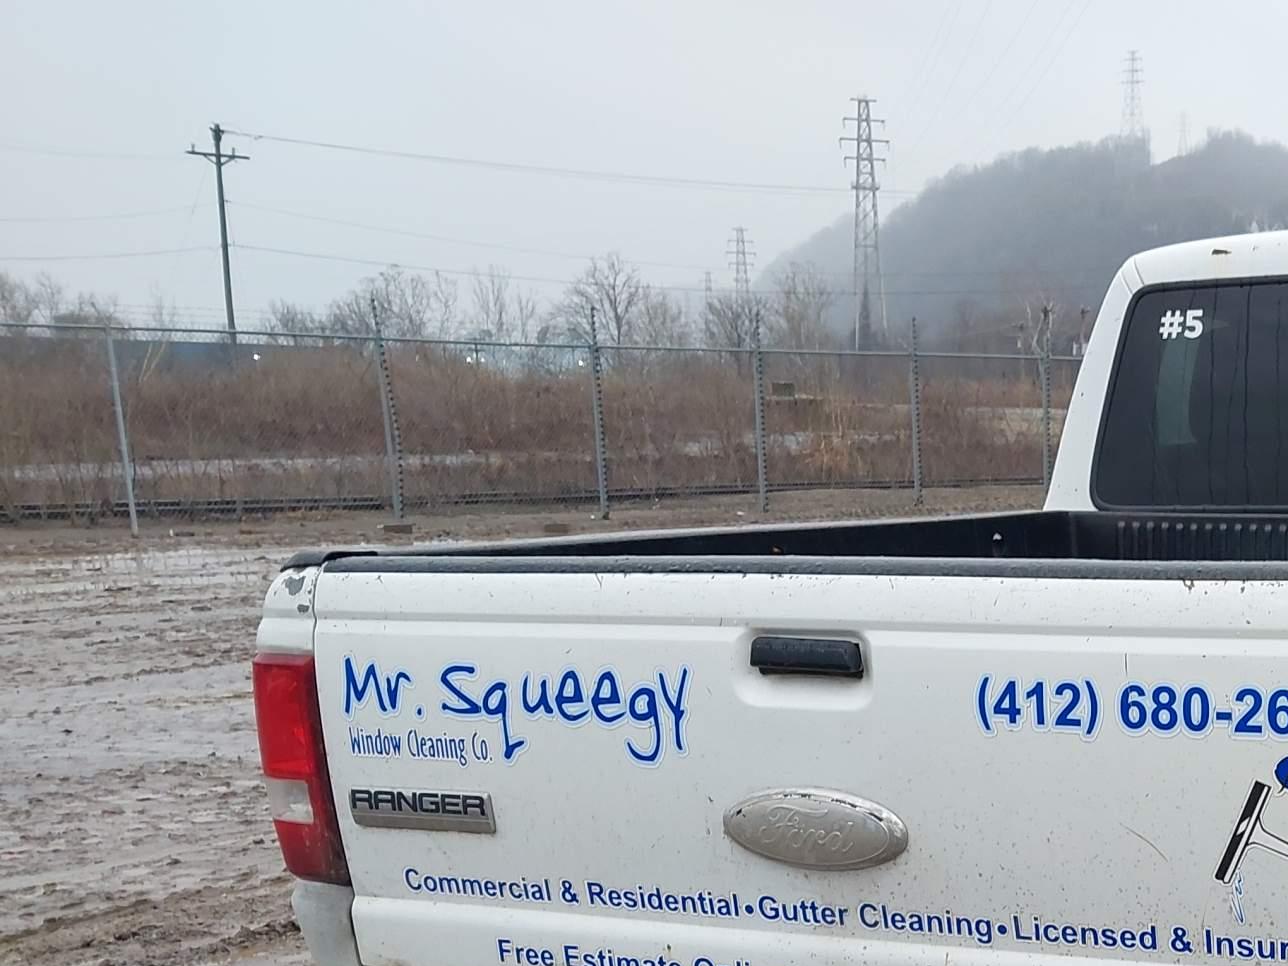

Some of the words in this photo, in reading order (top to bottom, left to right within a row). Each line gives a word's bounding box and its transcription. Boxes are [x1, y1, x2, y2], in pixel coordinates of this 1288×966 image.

[1159, 309, 1203, 339] #5
[344, 657, 423, 717] Mr.
[440, 665, 688, 761] Squeegy
[978, 676, 1098, 735] (412)
[348, 727, 402, 757] Window
[406, 729, 466, 766] Cleaning
[471, 732, 493, 762] Co.
[350, 789, 487, 817] RANGER
[759, 803, 853, 853] Ford
[405, 868, 552, 901] Commercial
[561, 880, 580, 904] &
[1170, 926, 1193, 953] &
